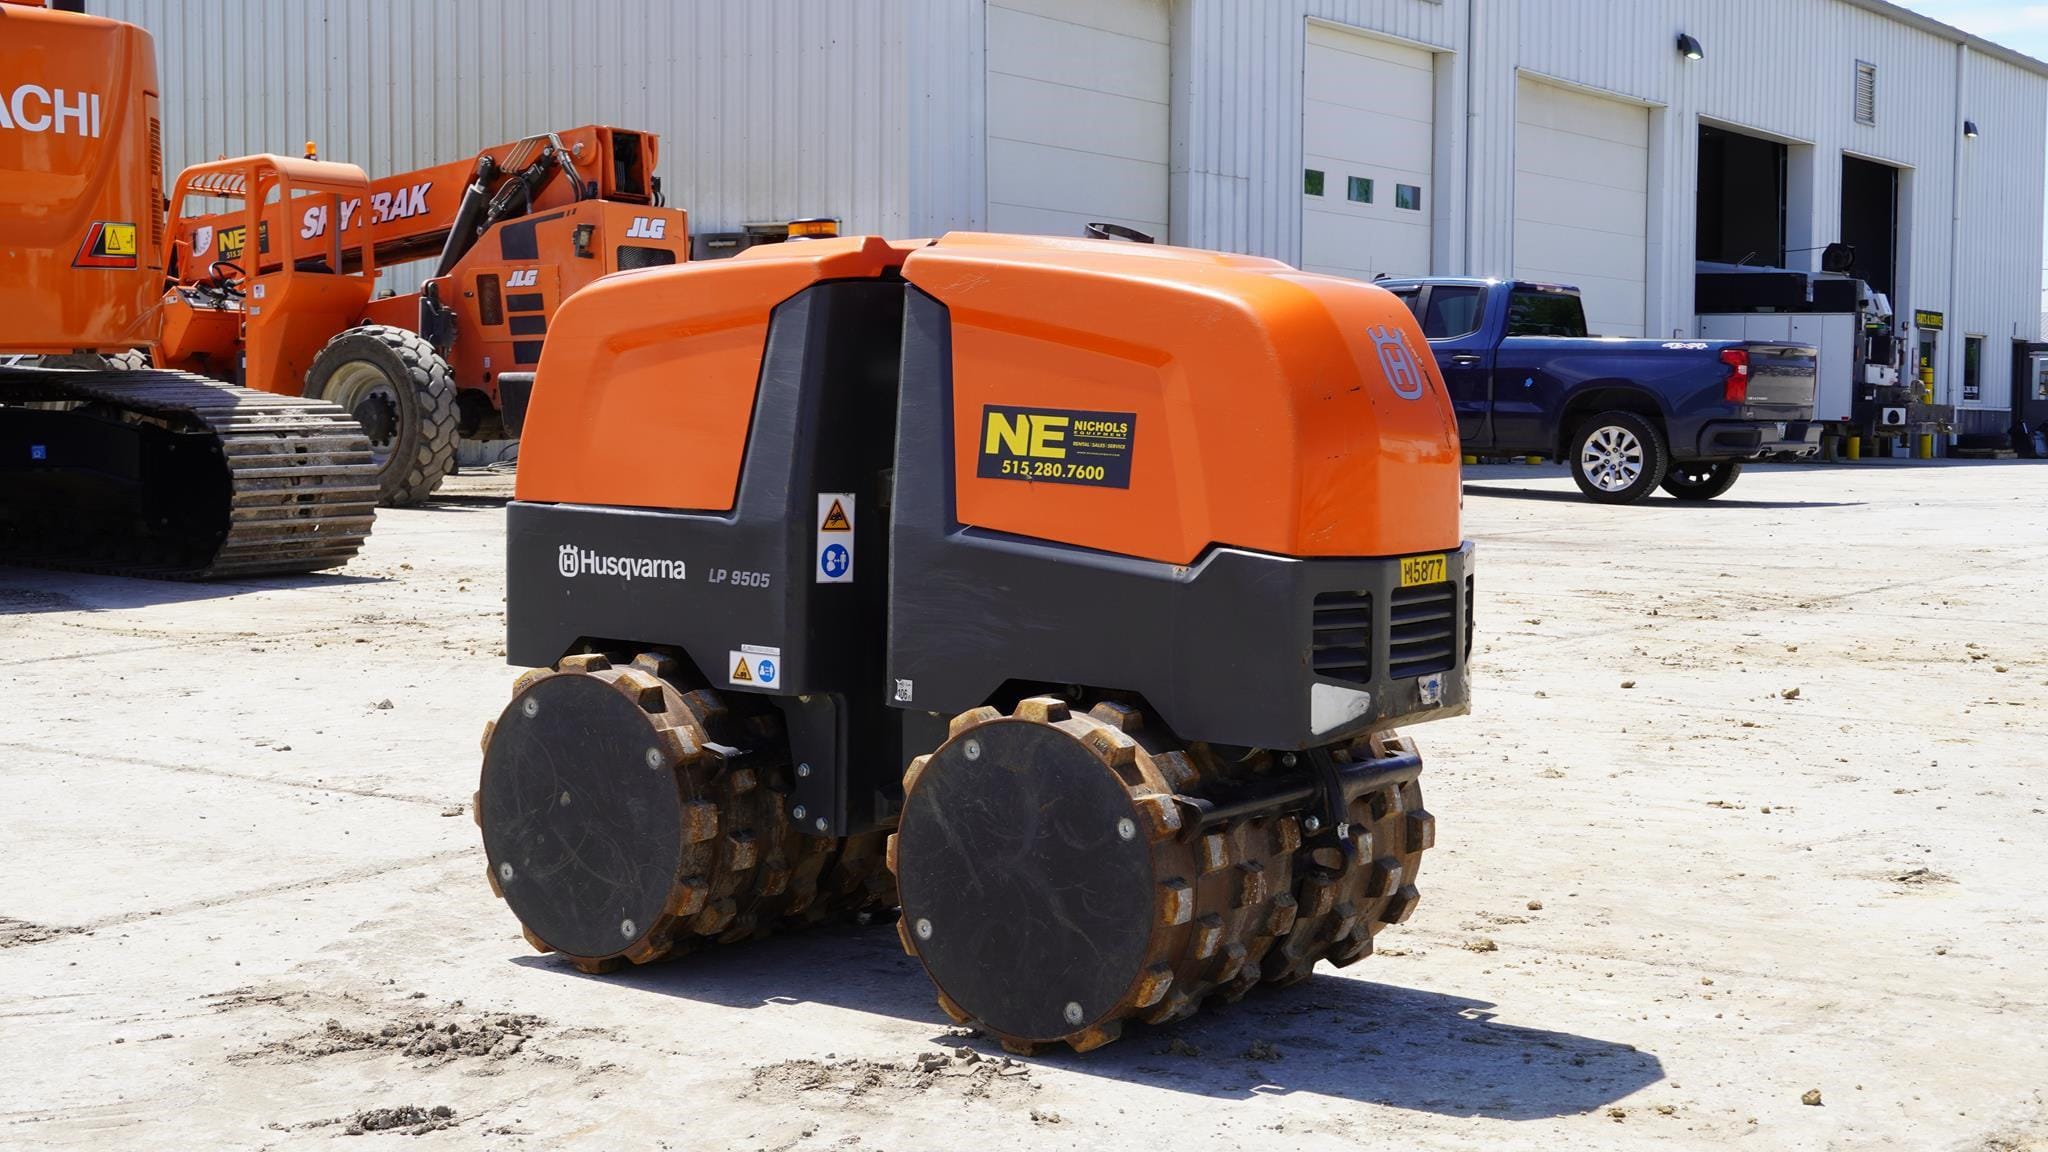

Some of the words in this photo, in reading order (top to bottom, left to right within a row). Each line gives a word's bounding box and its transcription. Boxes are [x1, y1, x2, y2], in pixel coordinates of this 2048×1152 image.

[300, 182, 432, 239] SYRAK
[626, 216, 667, 240] JLG
[505, 269, 539, 288] JLG
[985, 412, 1069, 459] NE
[1074, 420, 1128, 433] NICHOLS
[1001, 460, 1105, 480] 515.280.7600
[580, 550, 686, 580] Husqvarna
[709, 568, 727, 584] LP
[731, 570, 771, 588] 9505
